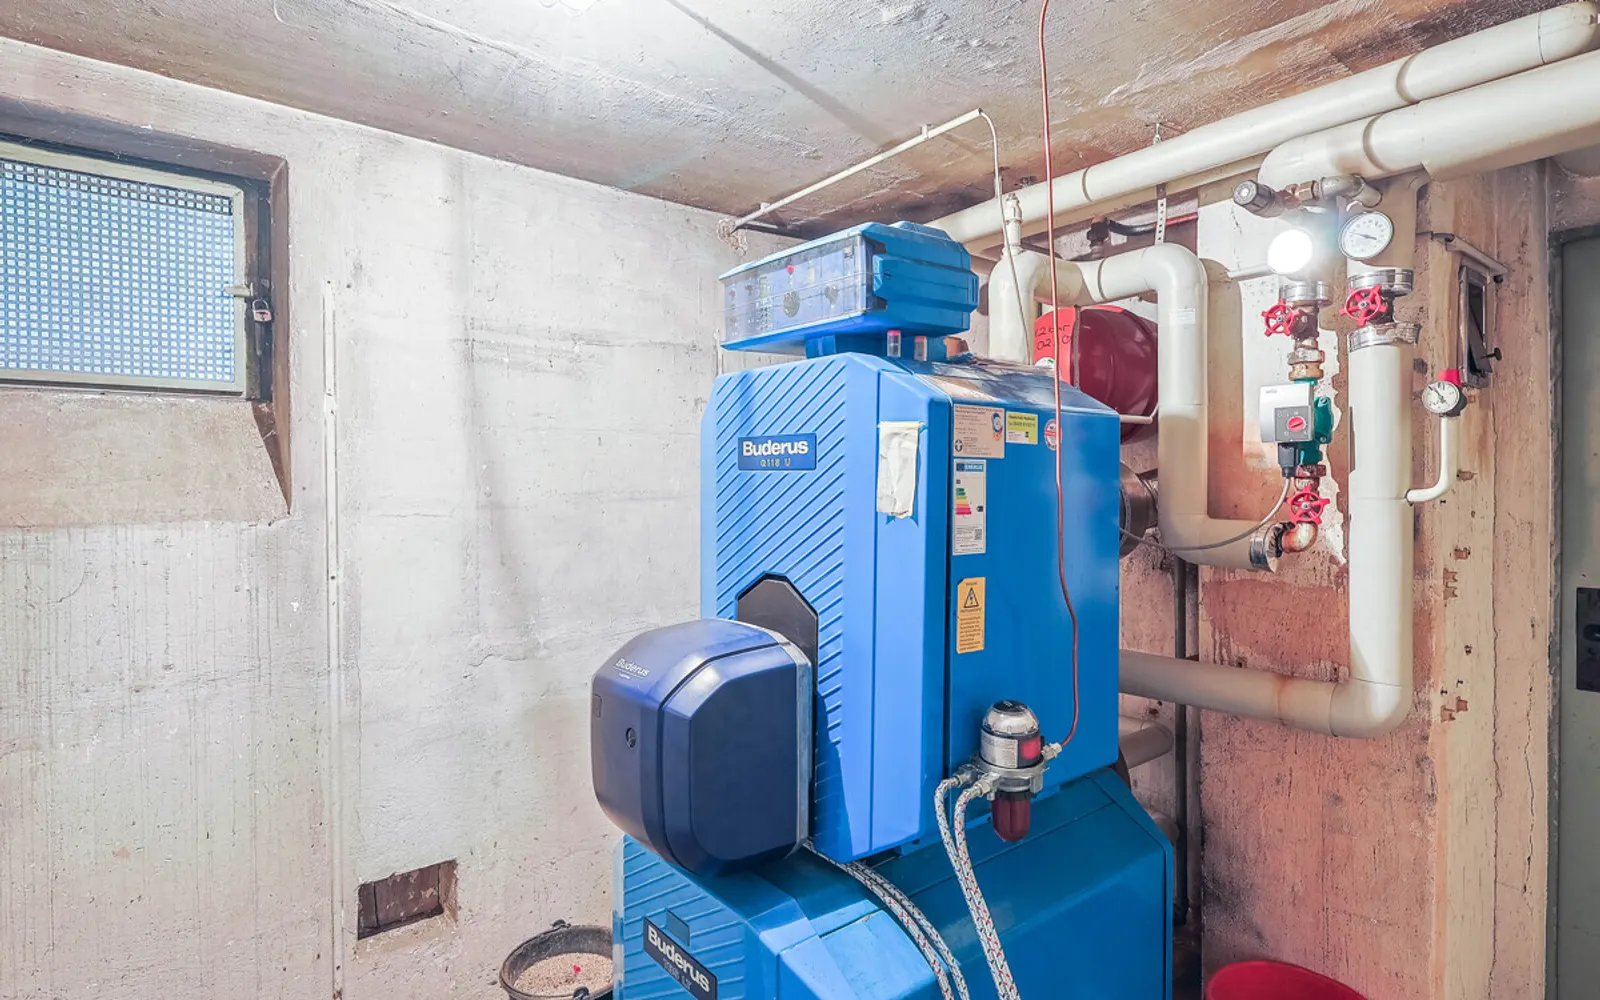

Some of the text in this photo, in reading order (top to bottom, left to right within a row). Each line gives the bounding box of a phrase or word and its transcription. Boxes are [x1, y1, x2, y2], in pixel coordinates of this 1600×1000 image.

[742, 439, 809, 456] Buderus
[615, 658, 651, 677] Buderus
[647, 925, 710, 993] Buderus
